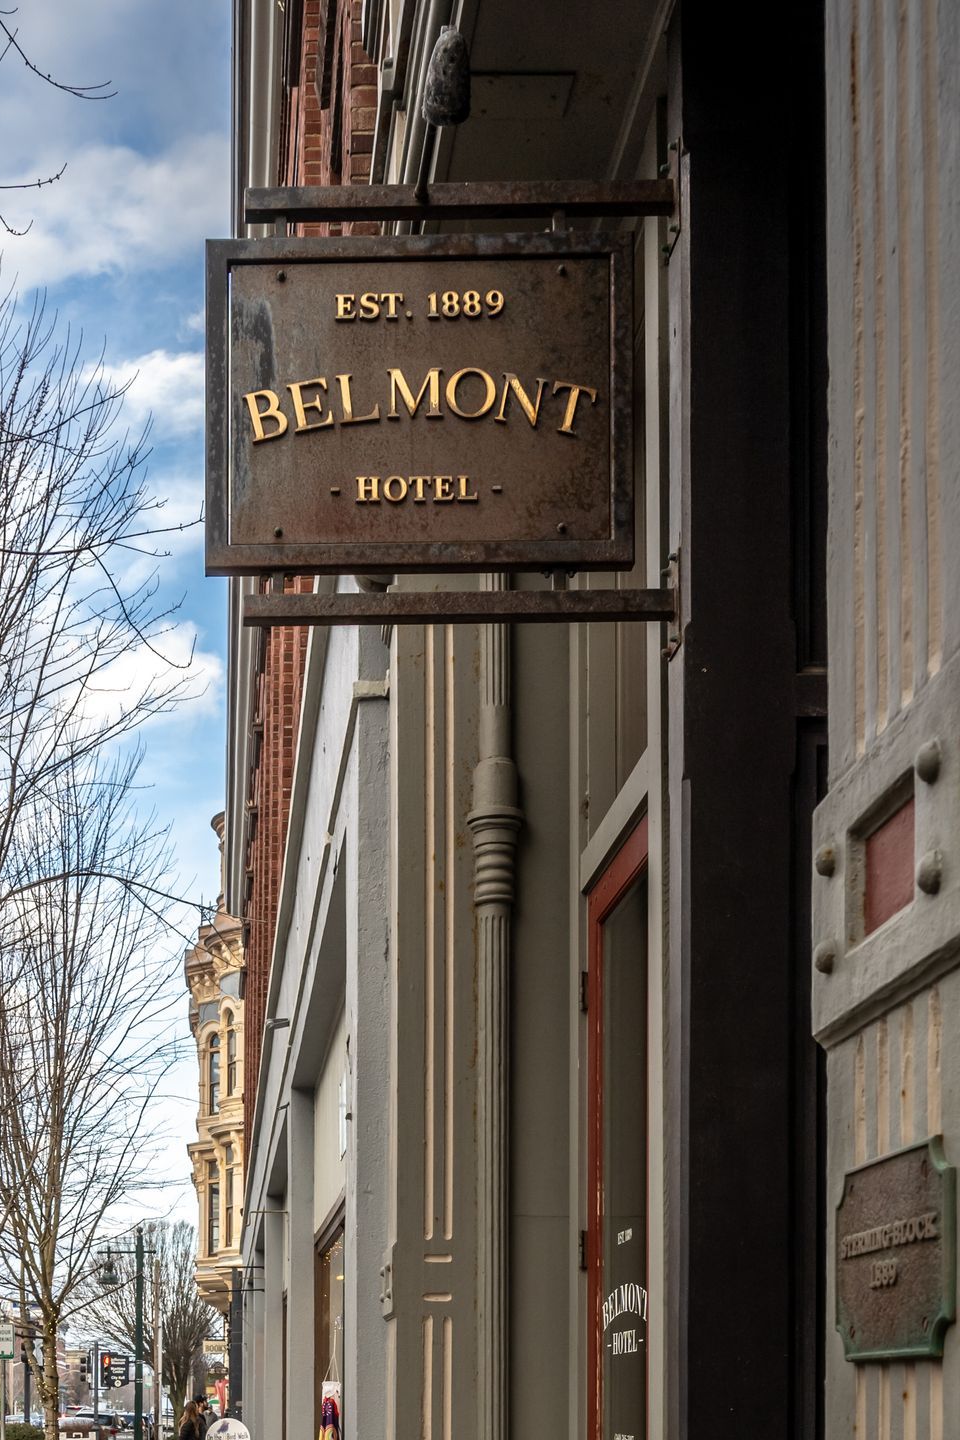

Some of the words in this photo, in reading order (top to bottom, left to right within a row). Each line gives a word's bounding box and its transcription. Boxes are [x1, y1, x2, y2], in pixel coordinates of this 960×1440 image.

[335, 292, 413, 321] EST.
[427, 290, 505, 319] 1889
[242, 367, 598, 445] BELMONT
[355, 475, 479, 504] HOTEL
[869, 1258, 897, 1288] 1889
[602, 1283, 647, 1332] BELMONT
[612, 1329, 638, 1355] HOTEL
